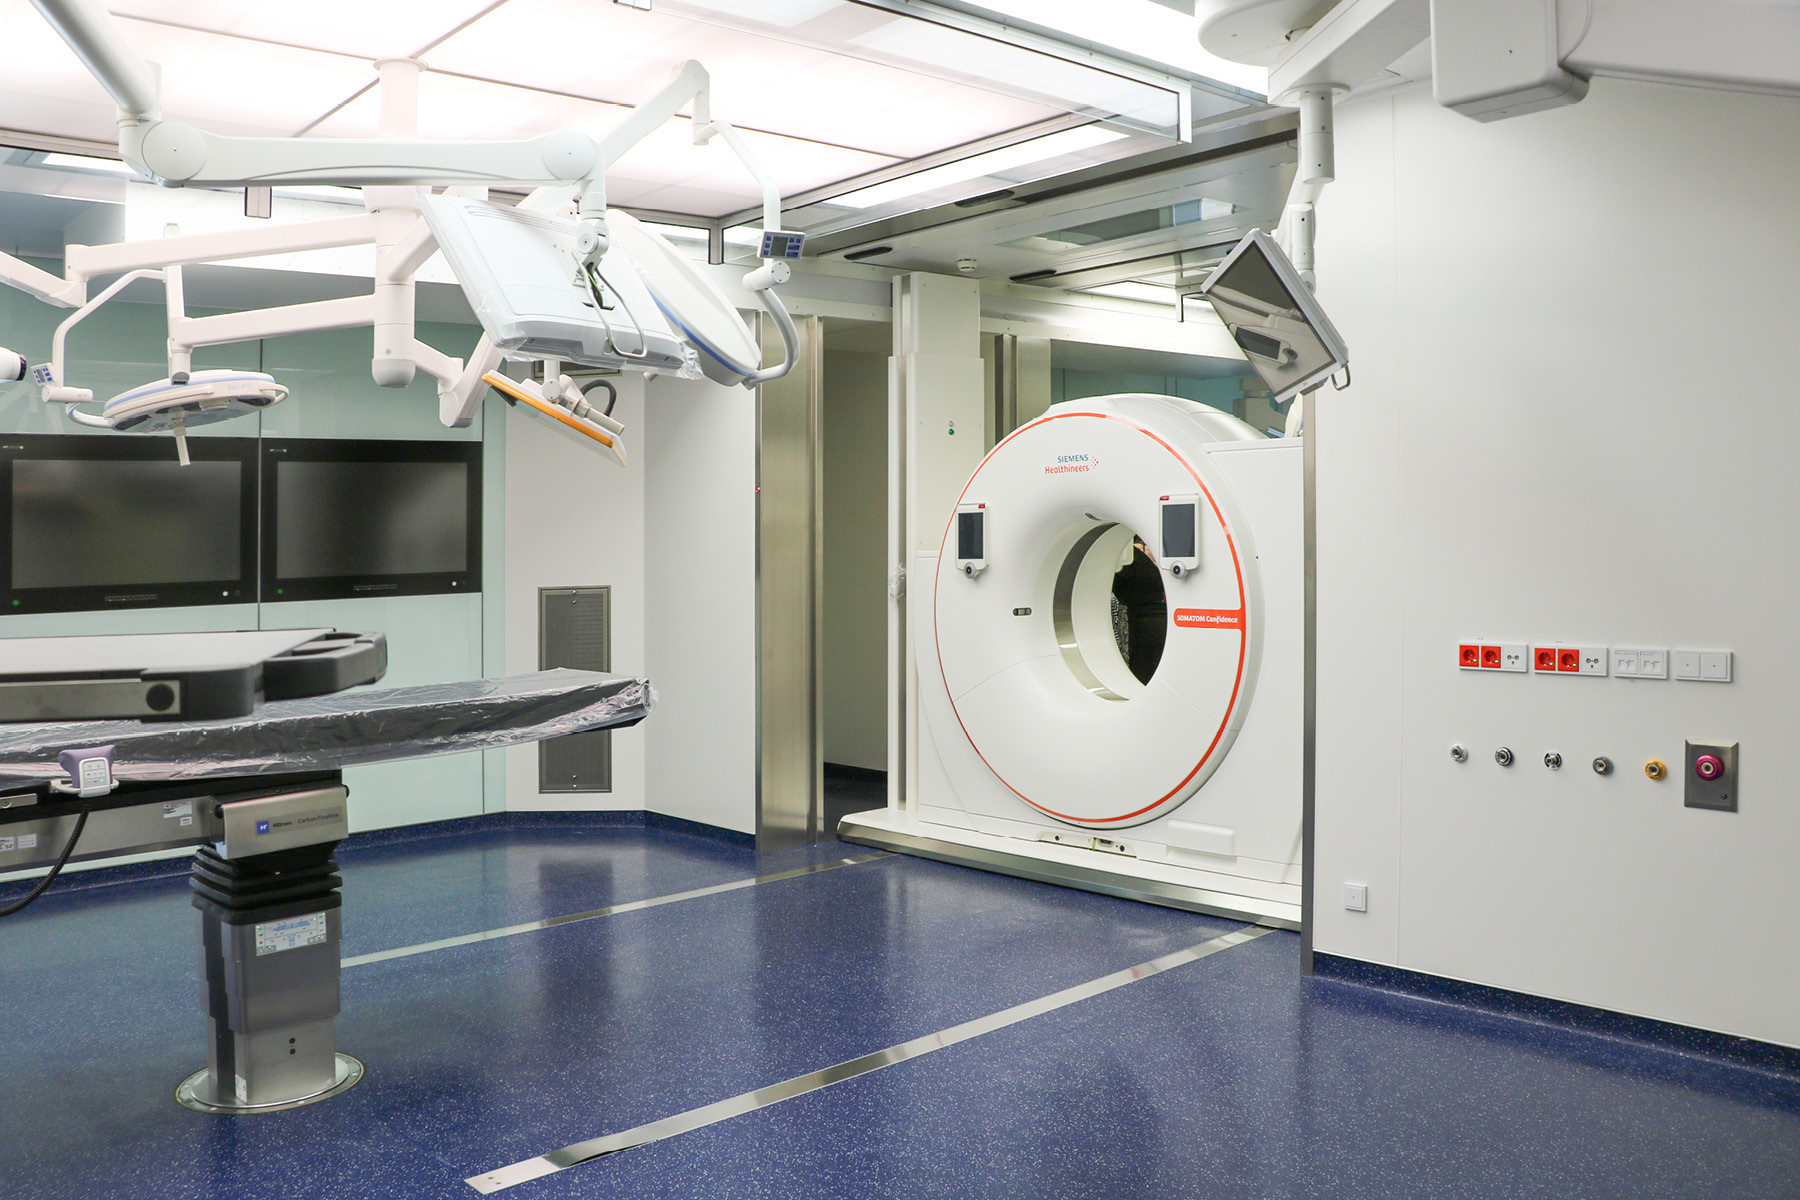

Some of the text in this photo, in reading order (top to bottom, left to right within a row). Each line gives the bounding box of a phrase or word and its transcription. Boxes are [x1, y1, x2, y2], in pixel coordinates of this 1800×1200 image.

[1057, 454, 1089, 463] SIEMENS
[1044, 464, 1090, 474] Healthineers
[1176, 614, 1238, 624] SOMATOM Confidence
